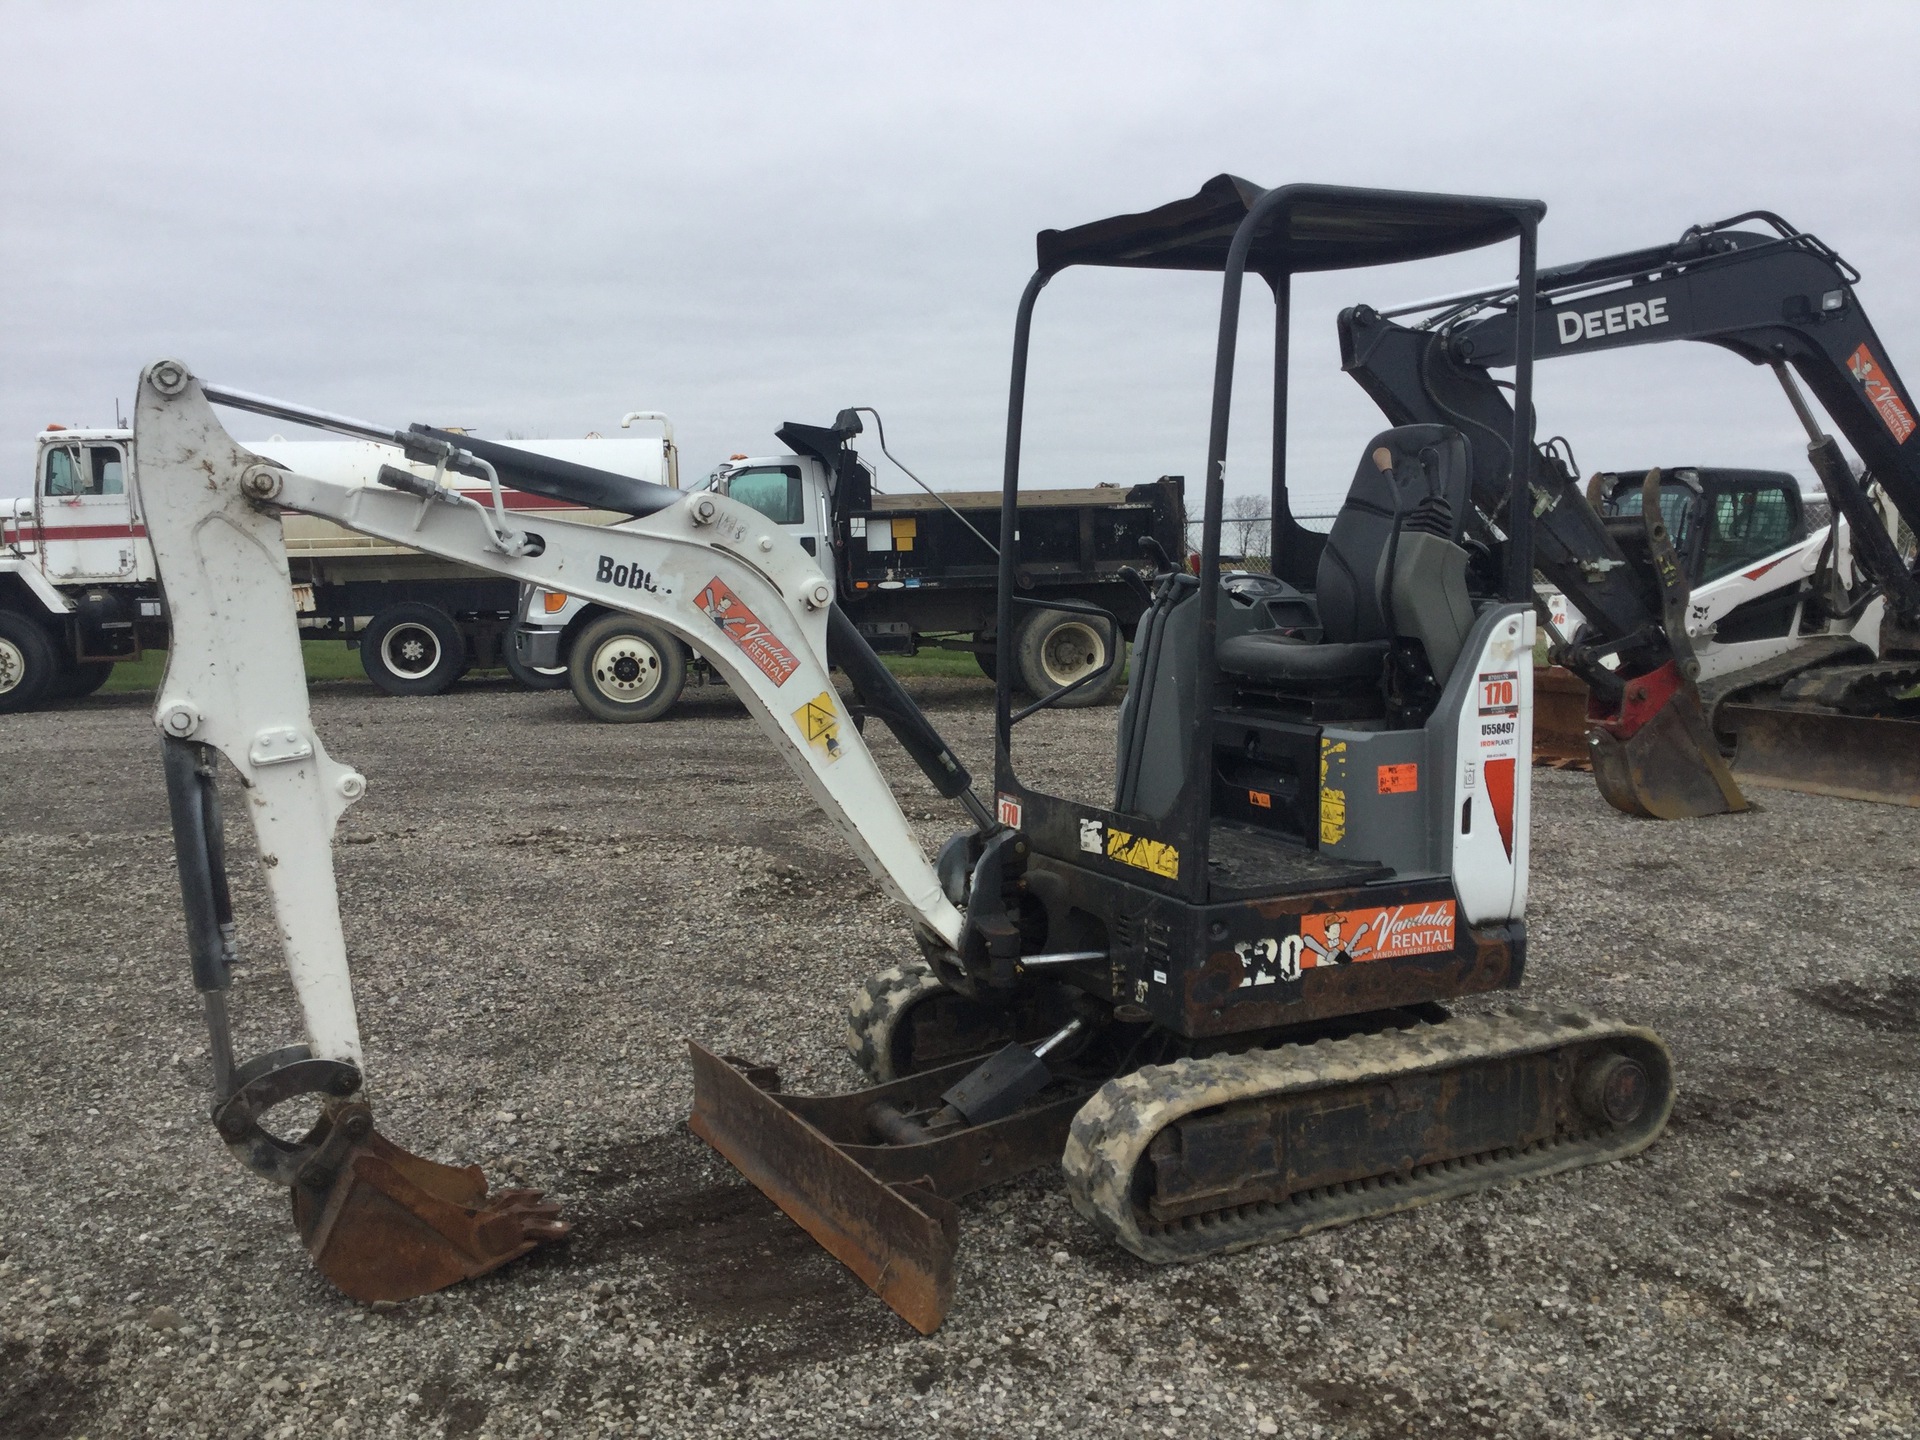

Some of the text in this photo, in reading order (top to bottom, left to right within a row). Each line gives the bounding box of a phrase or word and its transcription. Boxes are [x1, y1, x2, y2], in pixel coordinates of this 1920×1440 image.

[1557, 297, 1669, 345] DEERE
[1876, 386, 1911, 433] Vandalia
[1881, 403, 1905, 441] RENTAL
[740, 623, 793, 673] Vandalia
[748, 642, 784, 681] RENTAL
[1484, 681, 1513, 705] 170
[1481, 722, 1515, 735] U558497
[1002, 802, 1018, 826] 170
[1372, 905, 1453, 951] Vandalia
[1392, 929, 1452, 949] RENTAL
[1372, 943, 1453, 959] VANDALIARENTAL.COM
